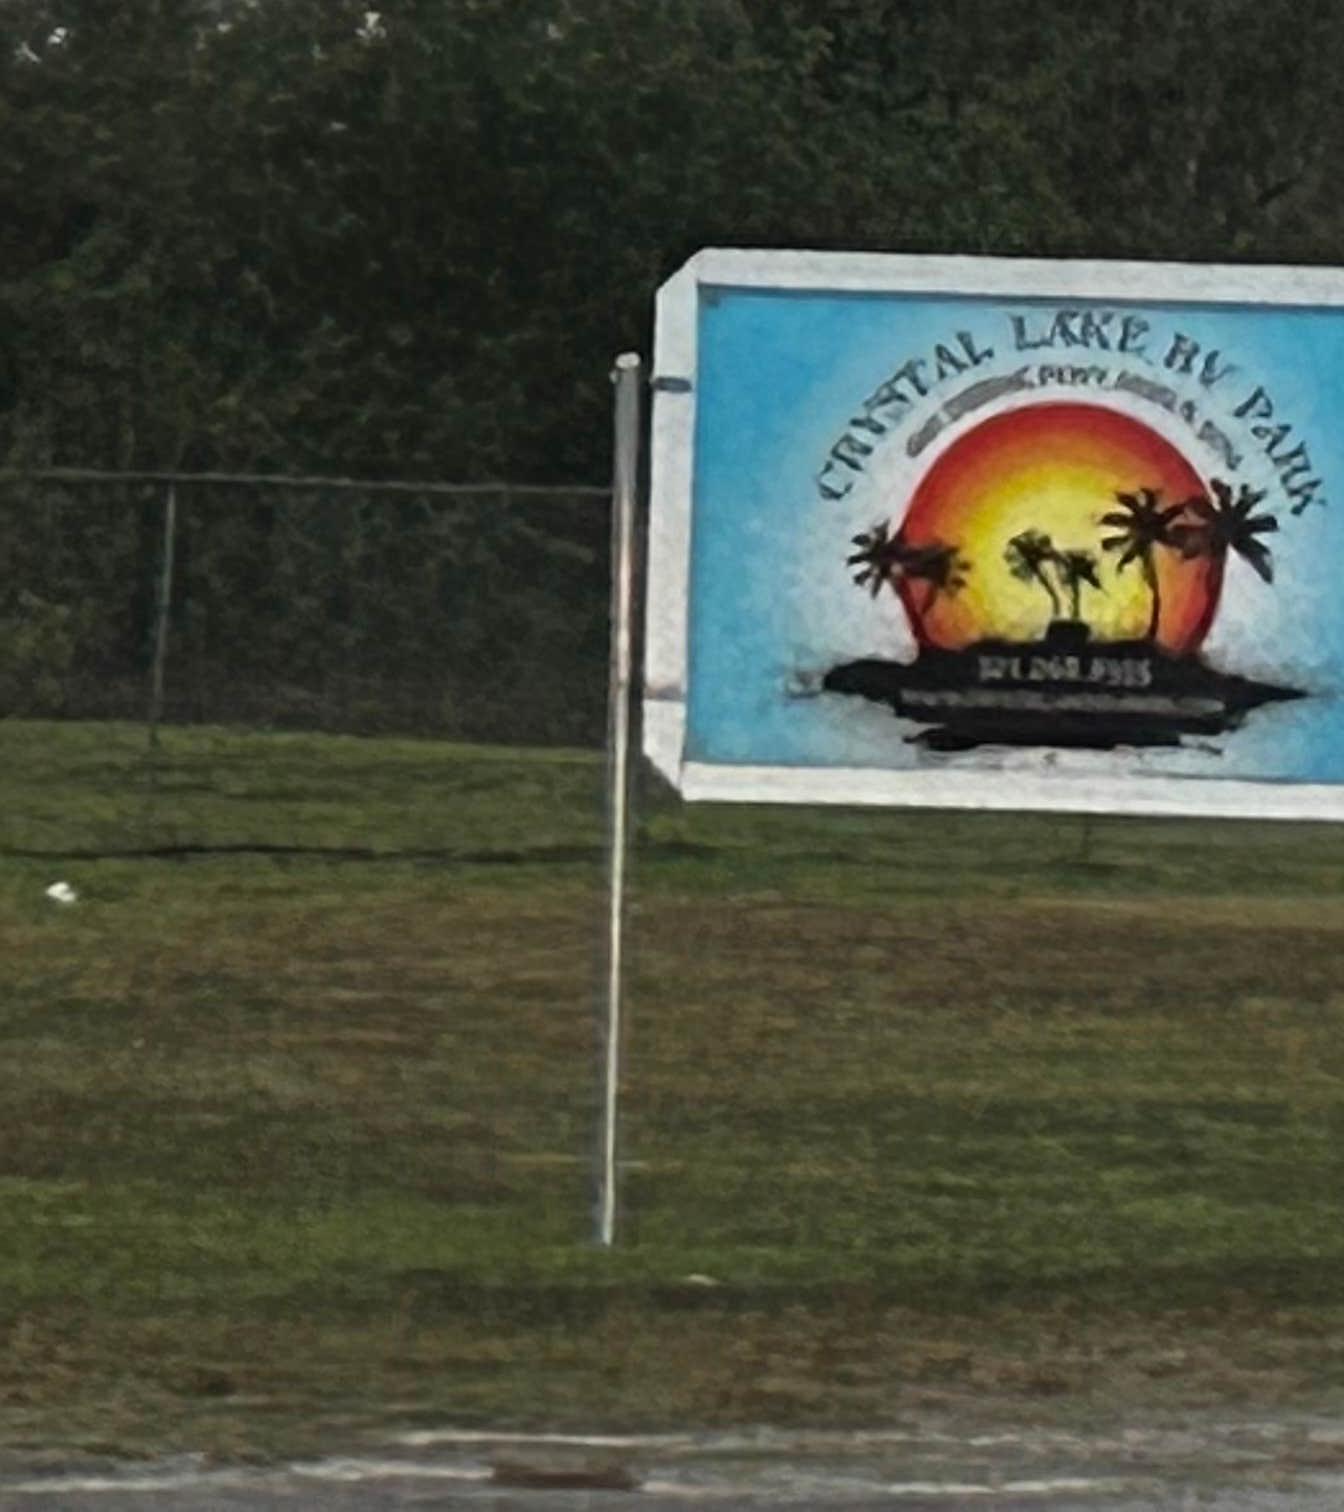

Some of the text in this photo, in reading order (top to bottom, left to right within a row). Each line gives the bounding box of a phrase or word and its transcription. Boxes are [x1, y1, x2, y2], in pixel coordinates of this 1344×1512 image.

[817, 330, 994, 501] CRYSTAL
[1010, 309, 1151, 356] LAKE
[1163, 332, 1239, 386] RV
[1232, 386, 1326, 516] PARK
